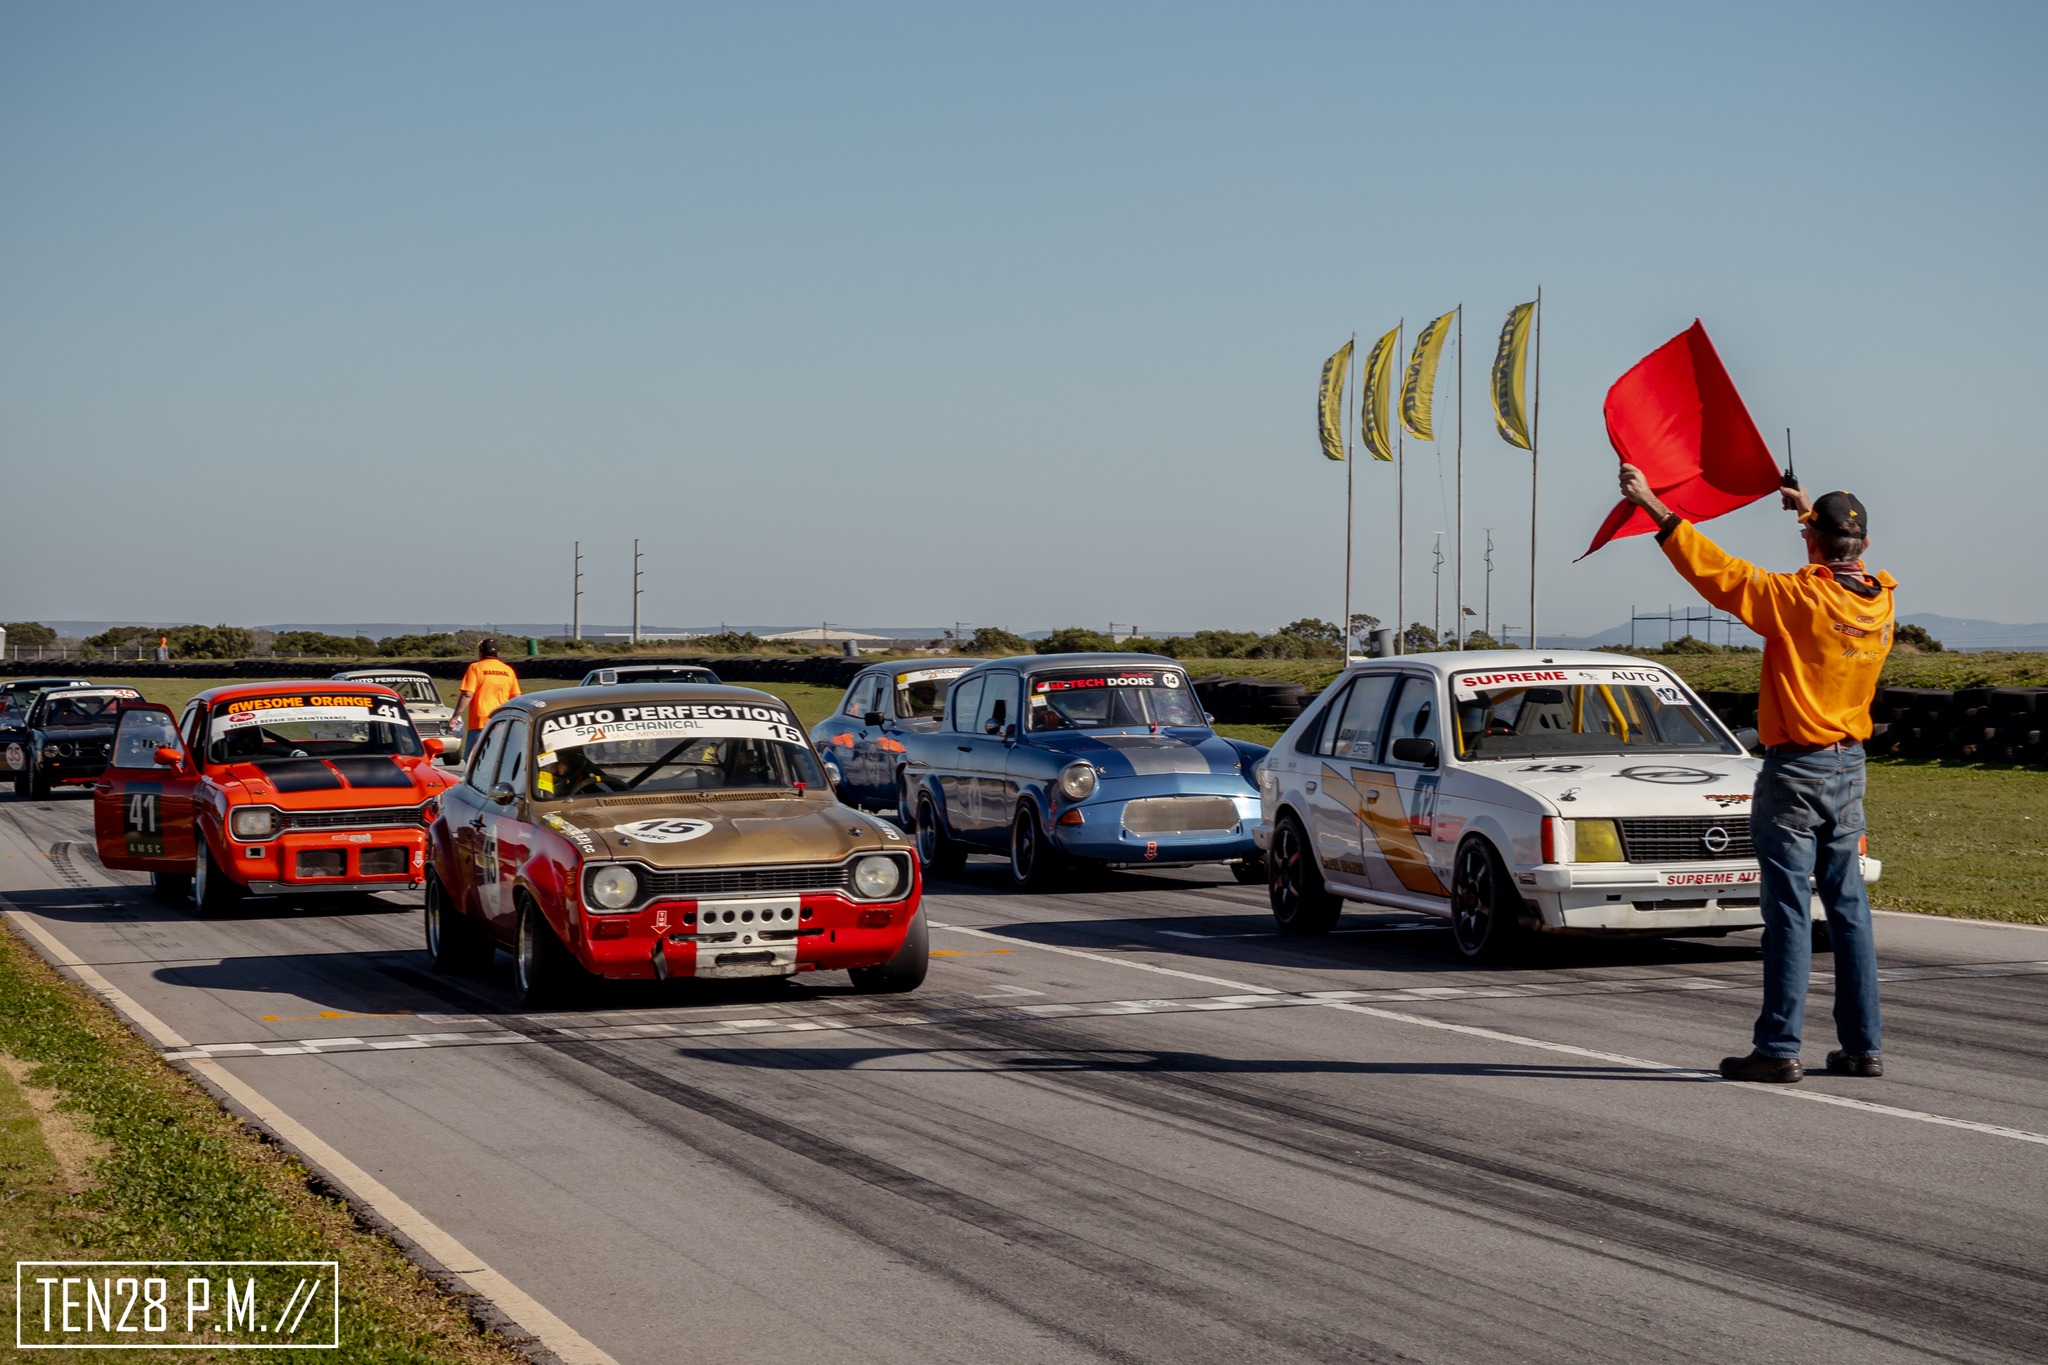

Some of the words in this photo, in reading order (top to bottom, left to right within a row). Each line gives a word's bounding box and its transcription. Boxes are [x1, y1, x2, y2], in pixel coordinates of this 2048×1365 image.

[482, 669, 510, 677] MARSHAL
[1462, 671, 1568, 687] SUPREME
[1611, 671, 1661, 683] AUTO
[1049, 678, 1105, 690] HI-TECH
[1106, 677, 1154, 687] DOORS
[1164, 676, 1177, 685] 14
[114, 689, 136, 699] 35
[1655, 687, 1686, 702] 12
[228, 697, 304, 715] AWESOME
[310, 695, 374, 708] ORANGE
[377, 704, 401, 720] 41
[229, 720, 258, 728] VEHICLE
[542, 708, 617, 735] AUTO
[621, 704, 790, 725] PERFECTION
[602, 720, 704, 733] MECHANICAL
[610, 732, 634, 740] SEAL
[636, 729, 688, 739] IMPORTERS
[767, 724, 801, 744] 15
[7, 746, 21, 762] 35
[1516, 764, 1585, 774] 12
[1418, 784, 1435, 826] 12
[129, 794, 156, 832] 41
[637, 820, 704, 834] 15
[129, 843, 161, 854] AMSC
[1667, 873, 1734, 885] SUPREME
